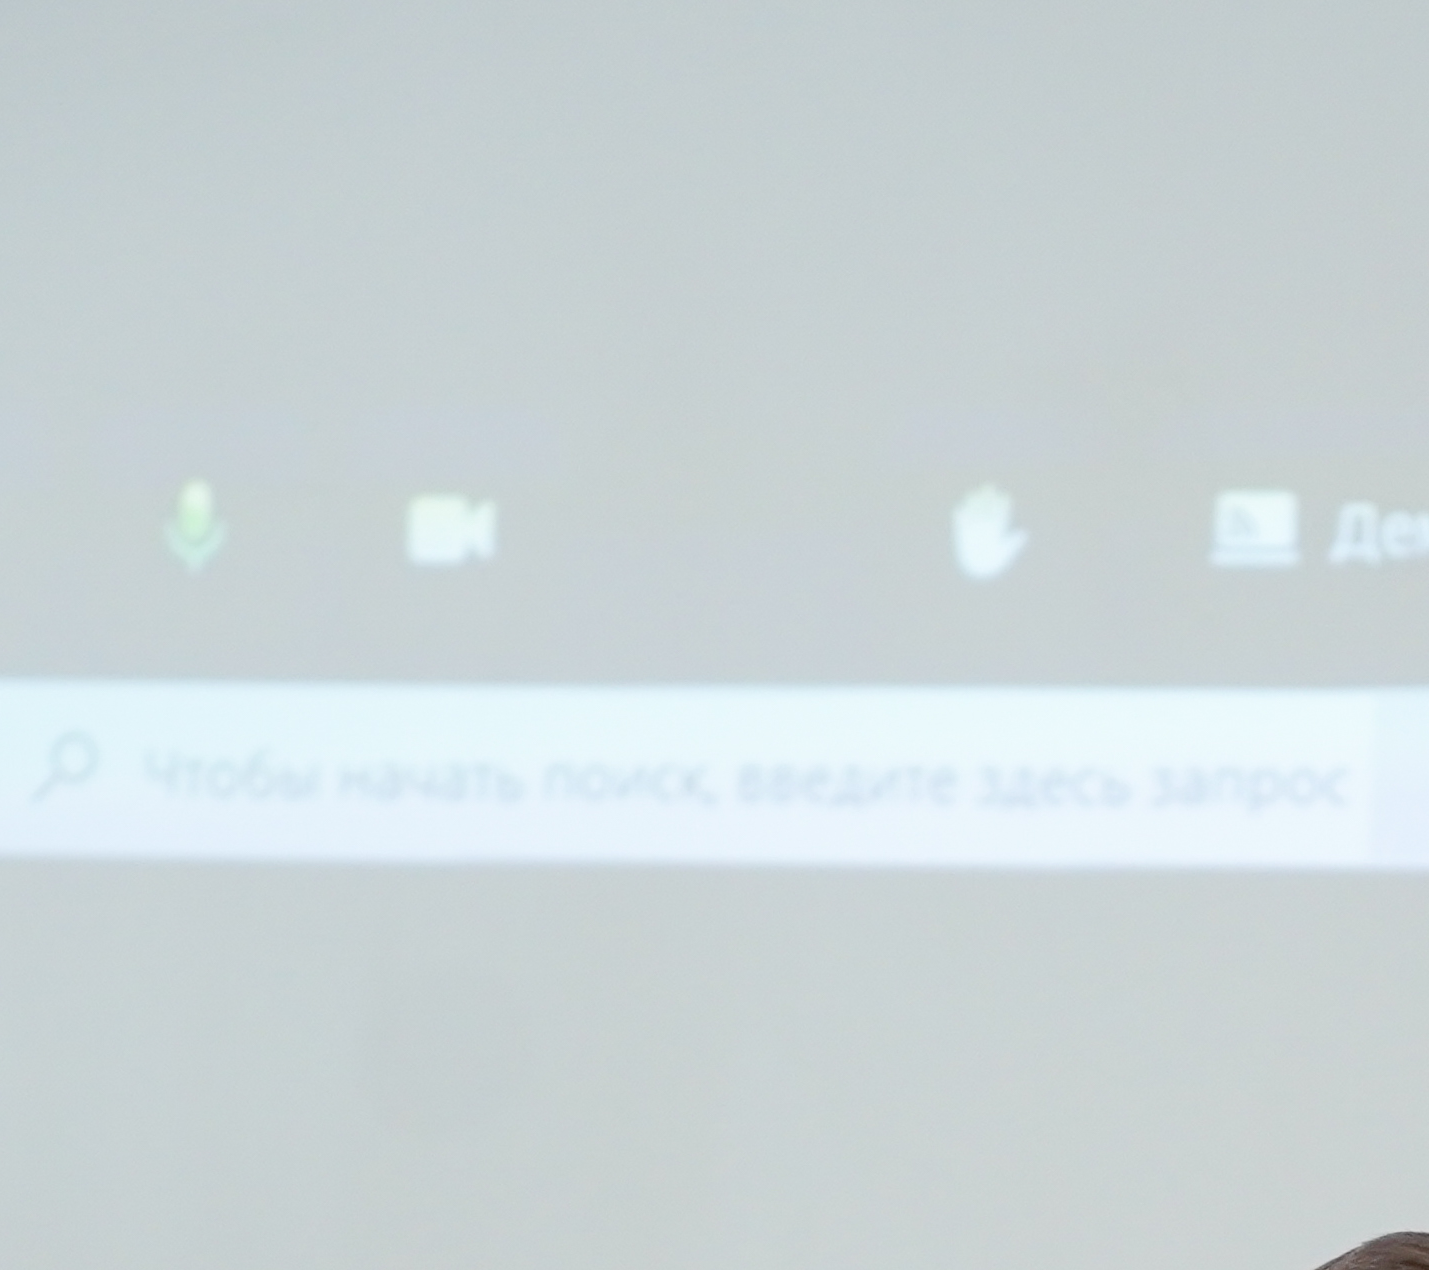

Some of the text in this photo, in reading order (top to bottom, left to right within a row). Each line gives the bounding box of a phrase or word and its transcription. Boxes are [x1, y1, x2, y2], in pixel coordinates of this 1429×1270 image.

[143, 745, 321, 802] Чтобы
[337, 759, 527, 805] начать
[736, 762, 960, 811] введите
[975, 764, 1133, 811] здесь
[1150, 764, 1350, 819] запрос
